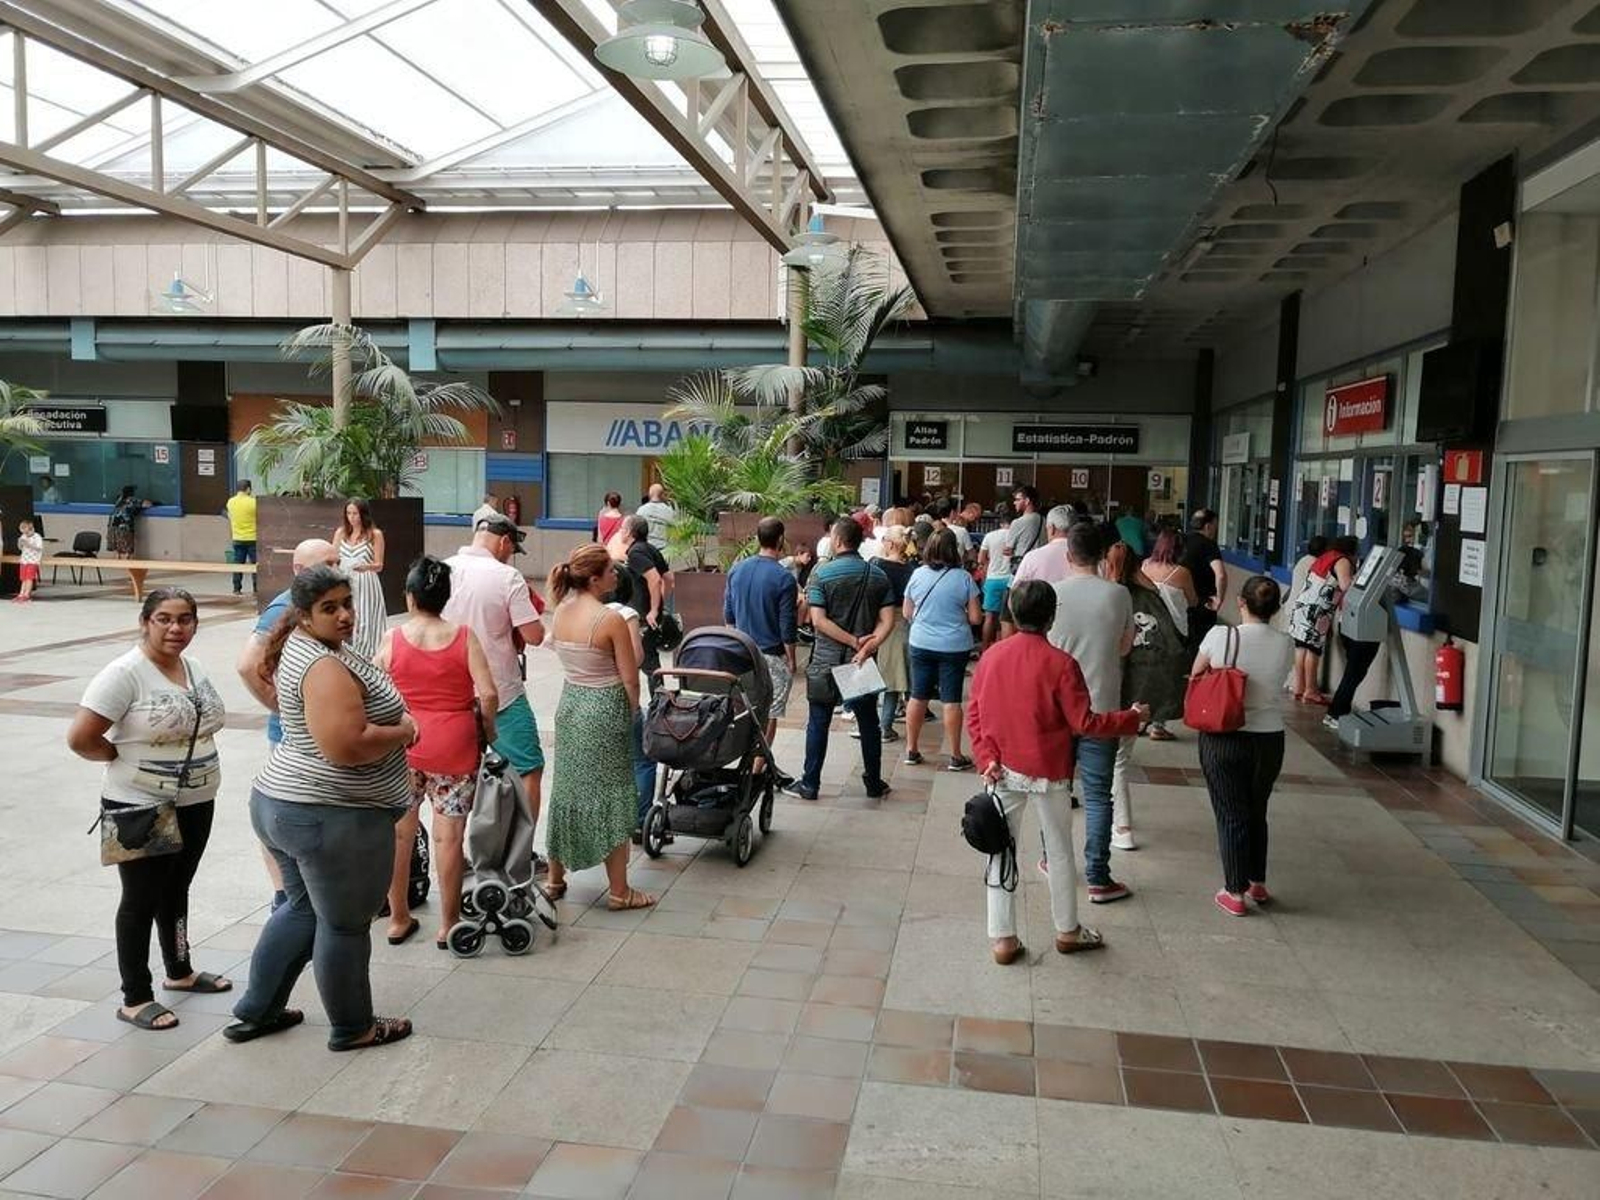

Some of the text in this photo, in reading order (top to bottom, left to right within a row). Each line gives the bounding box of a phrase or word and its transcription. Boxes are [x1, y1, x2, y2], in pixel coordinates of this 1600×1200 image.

[156, 449, 168, 460] 15
[925, 468, 940, 482] 12
[998, 469, 1012, 484] 11
[1072, 471, 1088, 486] 10
[1150, 473, 1162, 487] 9
[1374, 477, 1383, 504] 2
